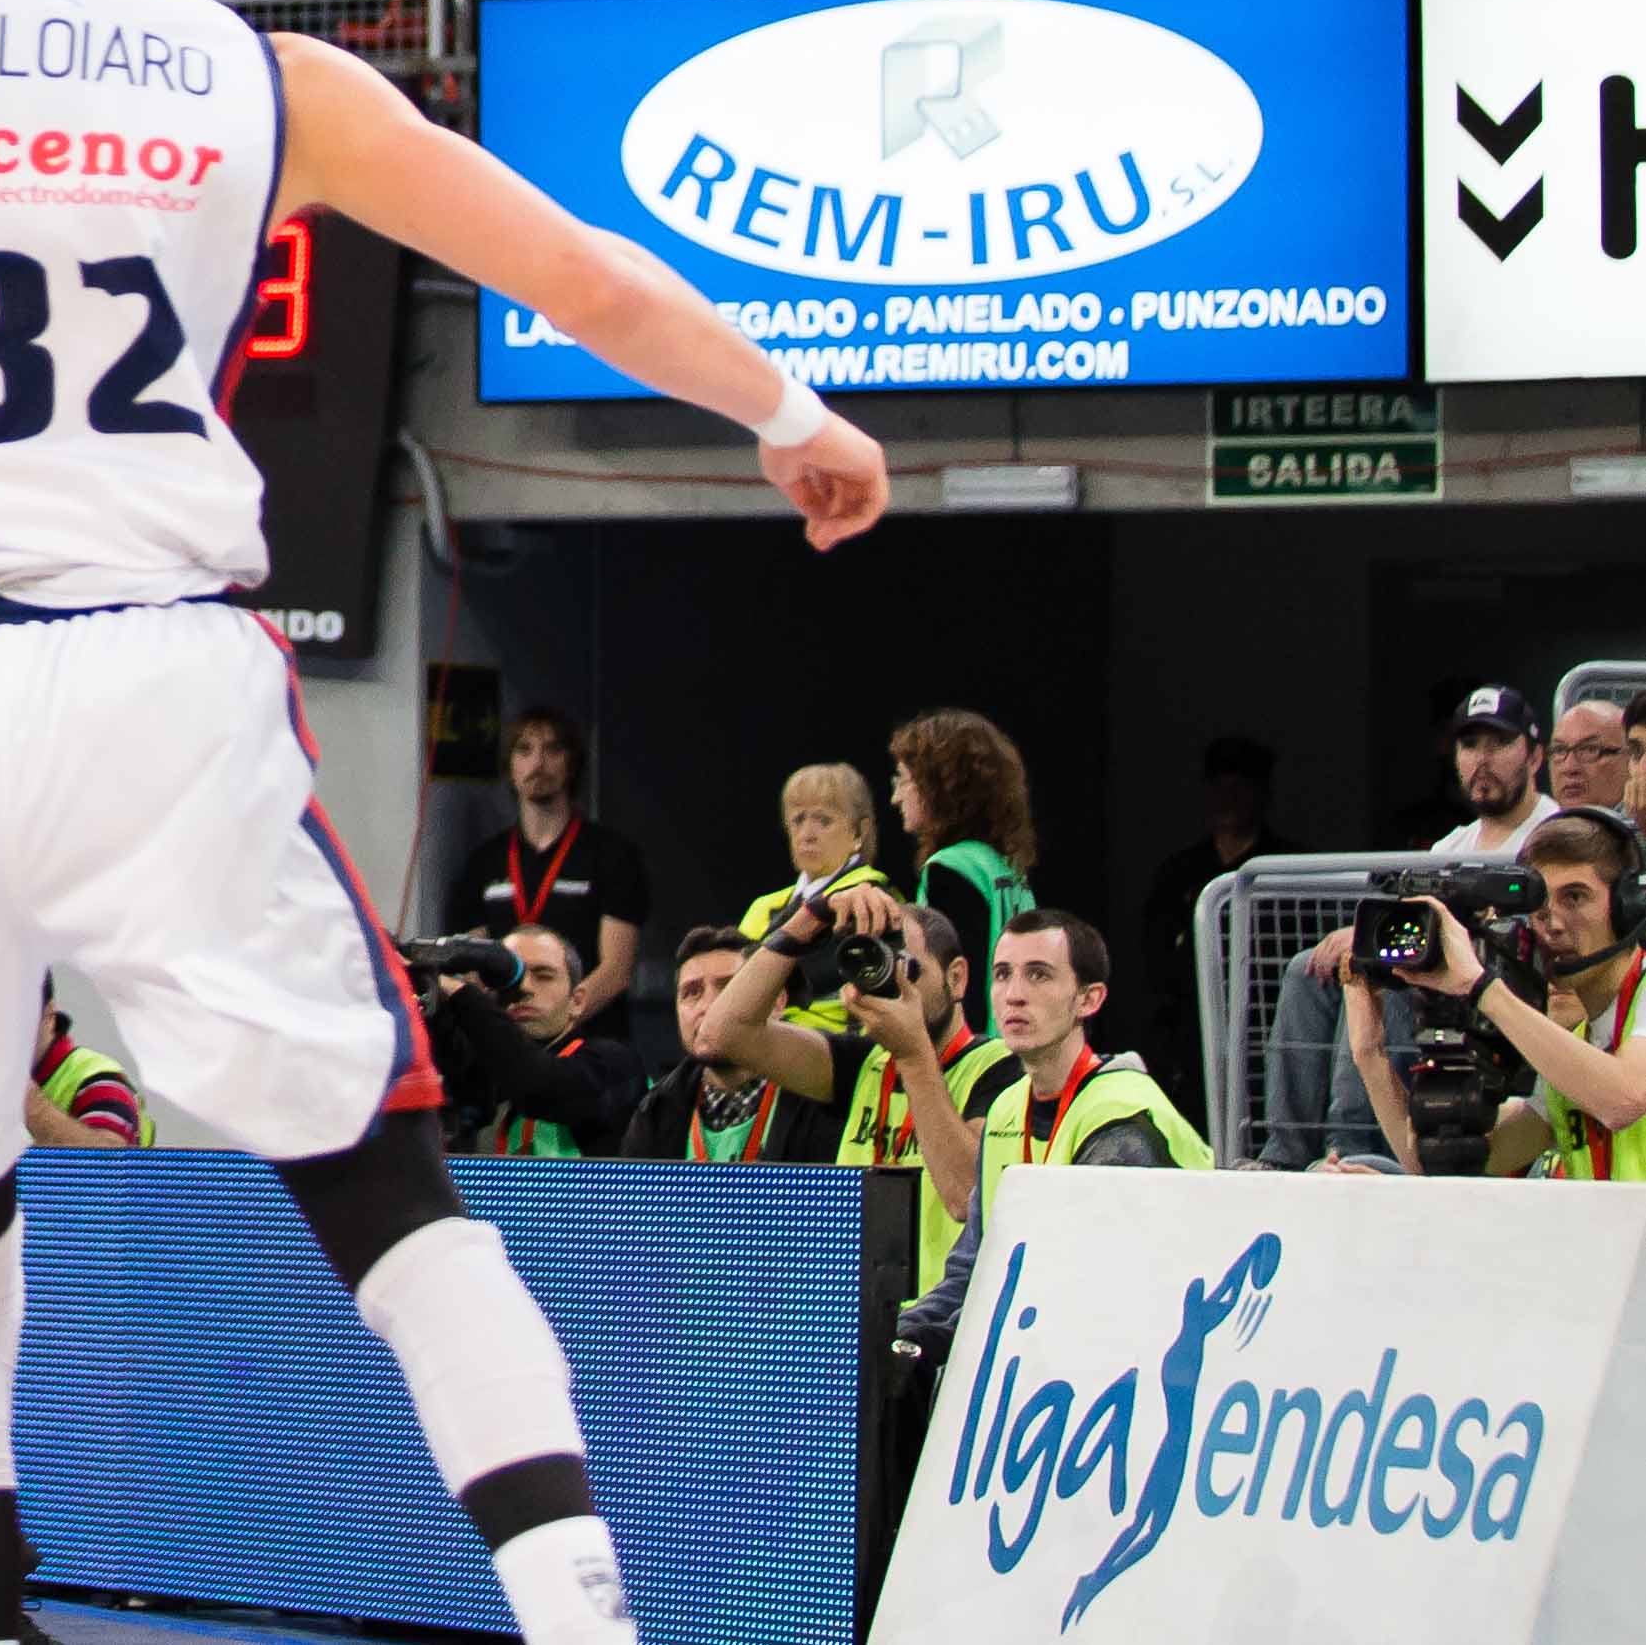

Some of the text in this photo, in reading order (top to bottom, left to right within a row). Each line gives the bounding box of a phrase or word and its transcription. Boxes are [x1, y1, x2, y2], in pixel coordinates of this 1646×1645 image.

[885, 293, 1102, 335] PANELADO
[1131, 286, 1387, 331] PUNZONADO
[1232, 394, 1412, 428] IRTEERA
[1247, 450, 1402, 489] SALIDA
[948, 1242, 1545, 1574] liga endesa
